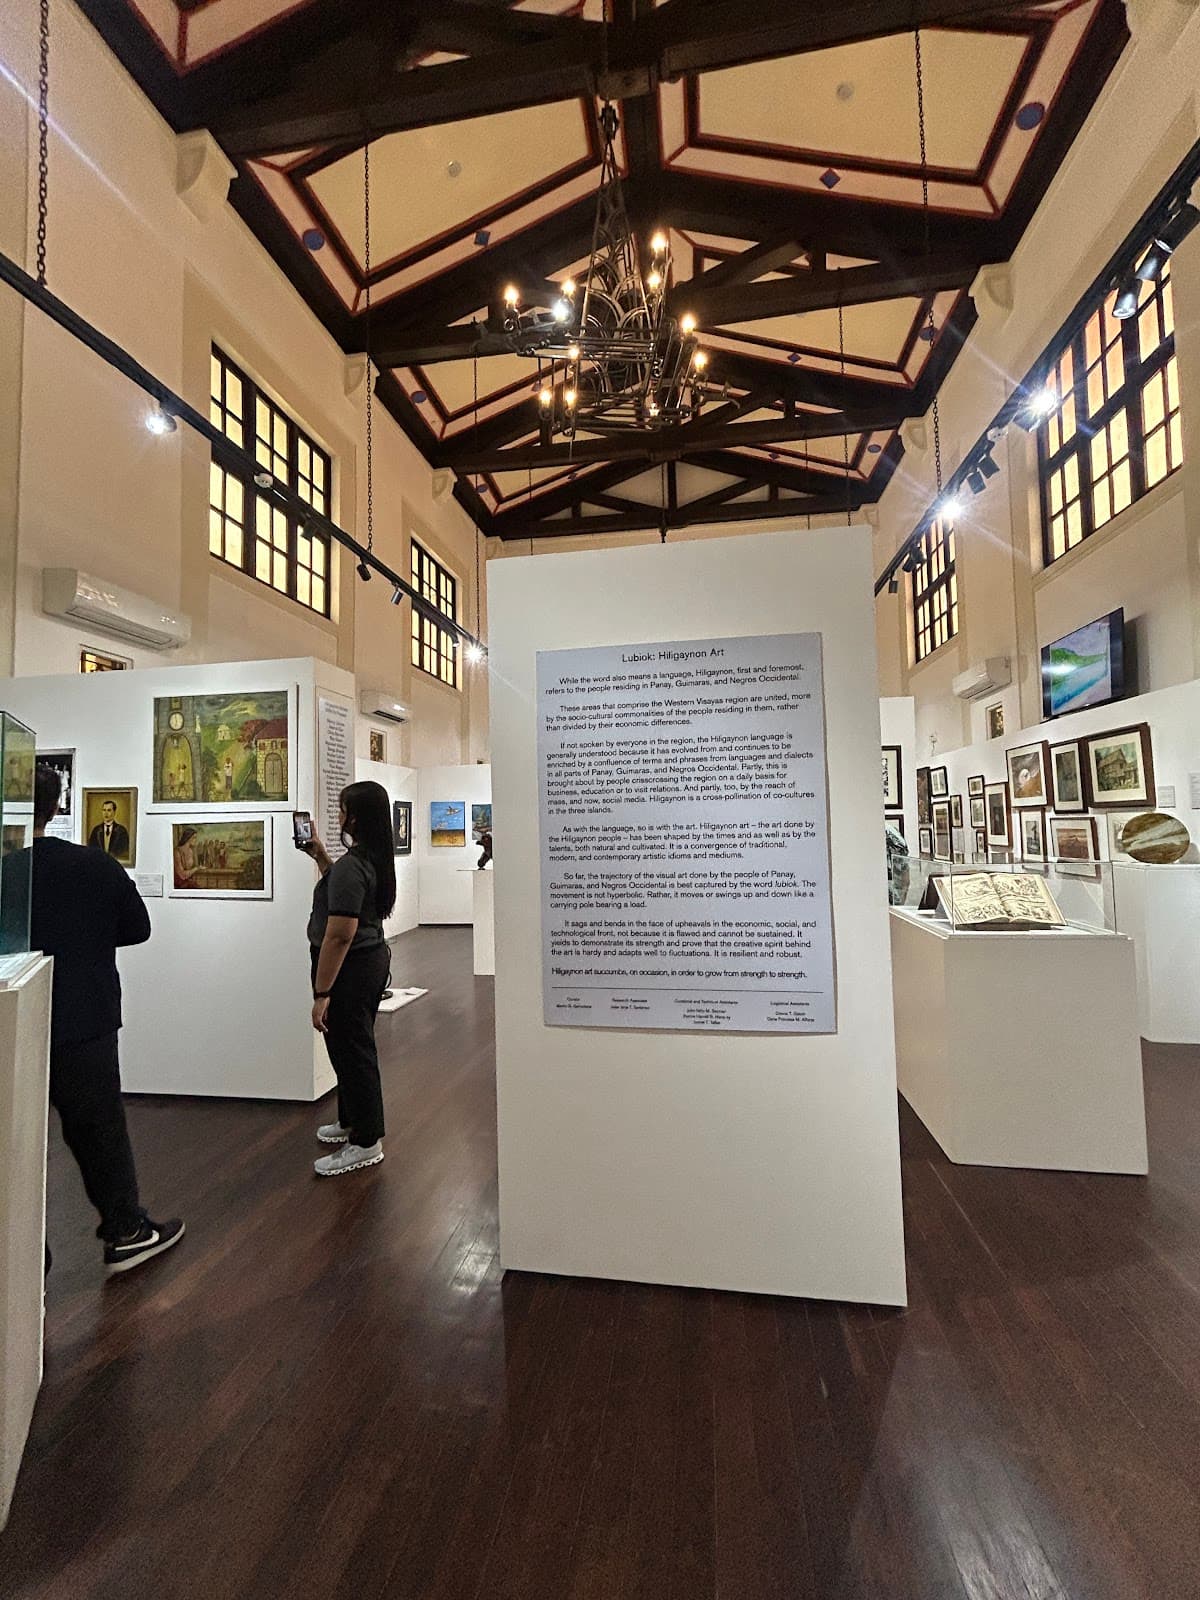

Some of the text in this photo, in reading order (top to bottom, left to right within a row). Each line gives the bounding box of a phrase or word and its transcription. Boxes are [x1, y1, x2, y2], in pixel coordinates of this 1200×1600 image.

[622, 648, 723, 662] Lubiok: Hiligaynon Art
[617, 701, 649, 709] comprise
[725, 696, 748, 704] region
[614, 710, 664, 718] commonalities
[688, 707, 712, 716] people
[588, 722, 596, 730] by
[579, 741, 603, 749] spoken
[605, 740, 614, 748] by
[670, 737, 696, 745] region,
[710, 735, 748, 743] Hiligaynon
[546, 751, 576, 760] generally
[547, 779, 573, 787] brought
[596, 778, 604, 786] by
[606, 777, 629, 785] people
[693, 774, 716, 782] region
[736, 773, 752, 781] daily
[649, 795, 685, 803] Hiligaynon
[694, 881, 726, 889] captured
[728, 881, 737, 889] by
[618, 949, 641, 957] adapts
